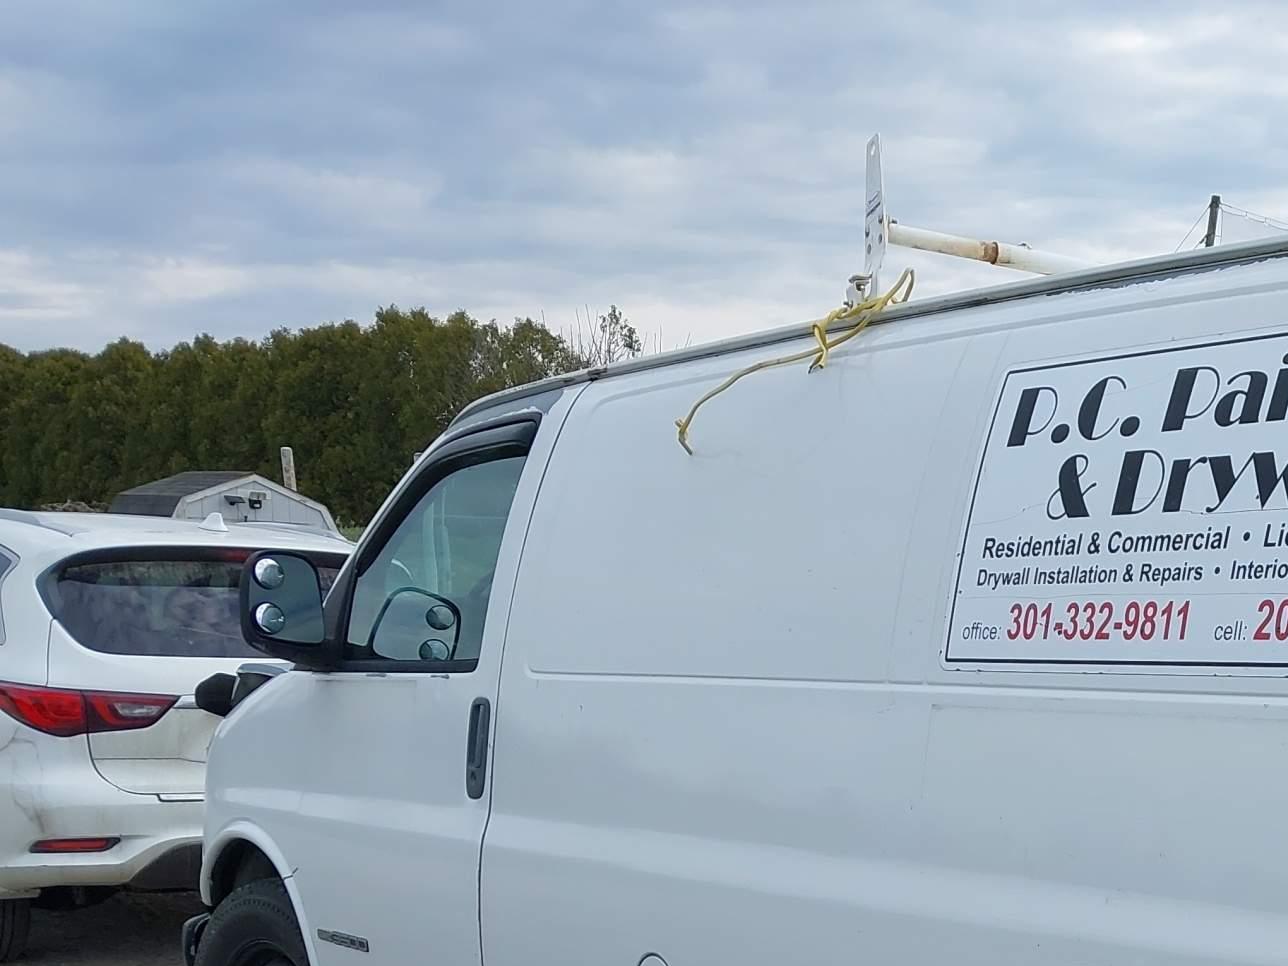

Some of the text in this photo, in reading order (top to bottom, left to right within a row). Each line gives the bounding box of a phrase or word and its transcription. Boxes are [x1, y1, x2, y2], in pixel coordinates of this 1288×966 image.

[1007, 376, 1140, 447] P.C.
[1047, 454, 1096, 520] &
[983, 534, 1082, 558] Residential
[1088, 532, 1100, 554] &
[1108, 526, 1230, 553] Commercial
[977, 568, 1030, 590] Drywall
[1034, 565, 1117, 584] Installation
[1123, 564, 1133, 582] &
[1140, 562, 1203, 586] Repairs
[963, 622, 1001, 640] office:
[1007, 601, 1190, 640] 301-332-9811
[1215, 621, 1247, 640] cell:
